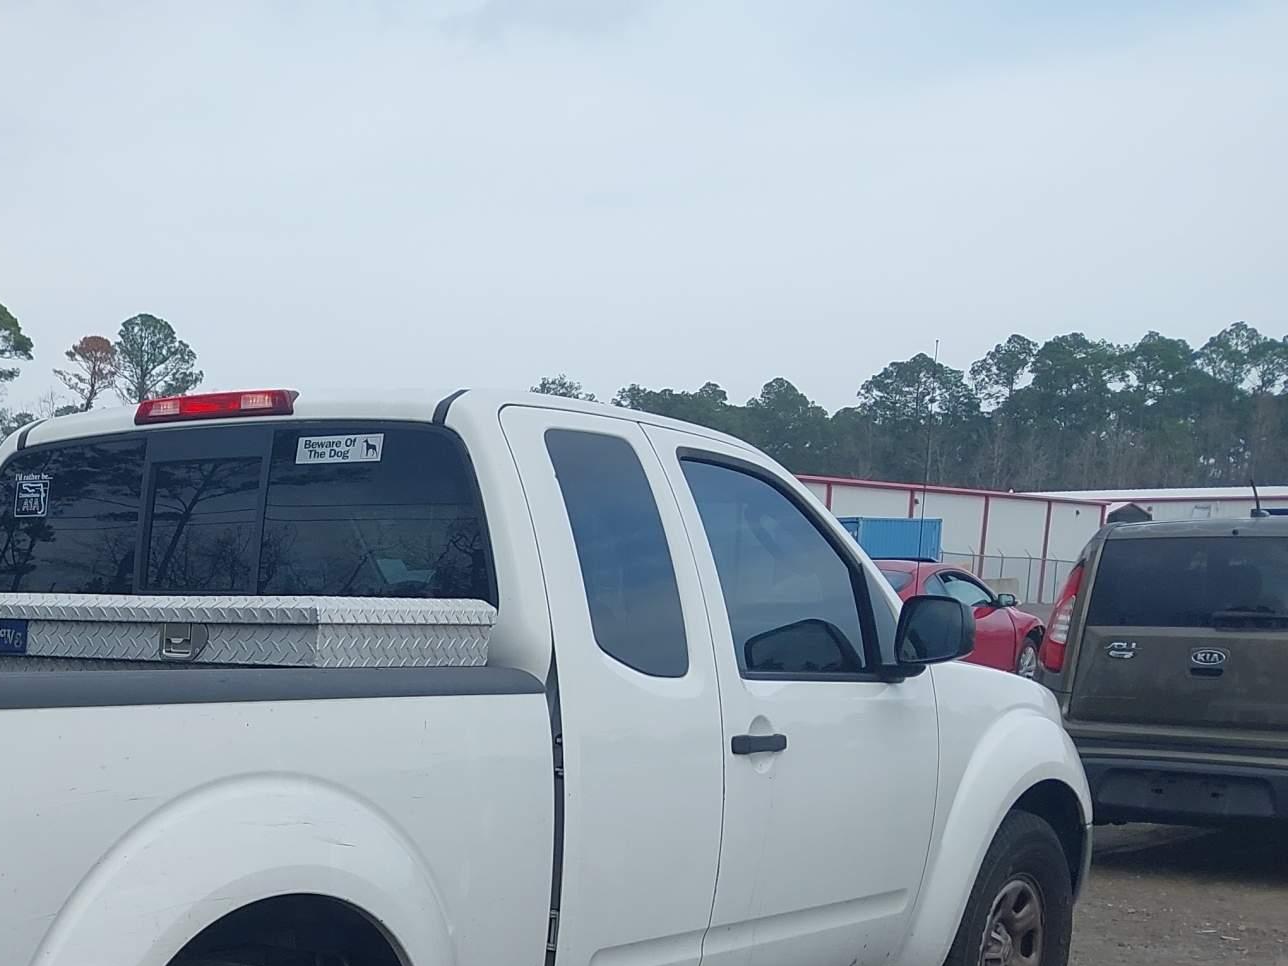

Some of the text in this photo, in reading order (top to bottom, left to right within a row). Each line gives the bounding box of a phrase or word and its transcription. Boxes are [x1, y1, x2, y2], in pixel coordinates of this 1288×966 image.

[304, 438, 357, 449] Beware Of
[308, 448, 350, 460] The Dog
[1196, 652, 1220, 662] KIA
